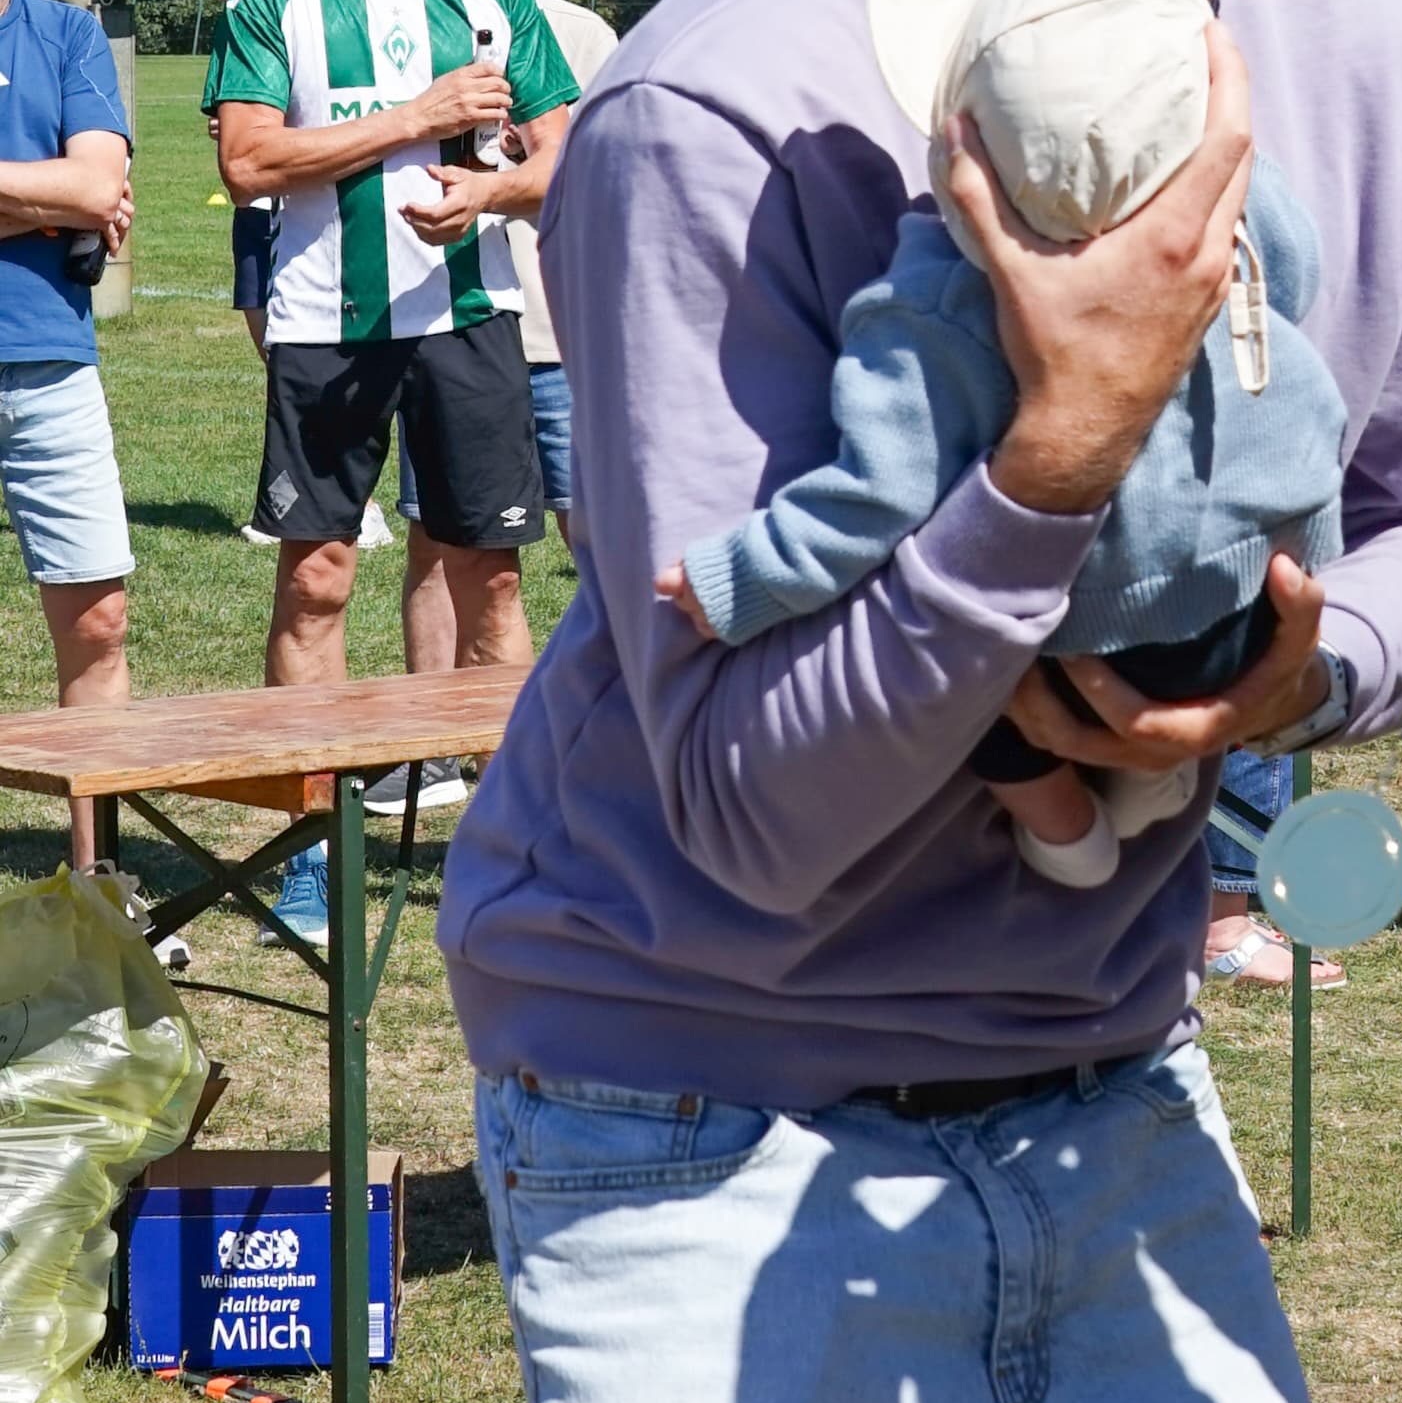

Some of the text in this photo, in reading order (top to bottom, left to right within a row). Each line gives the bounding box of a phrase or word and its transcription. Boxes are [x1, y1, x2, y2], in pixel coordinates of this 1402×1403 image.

[200, 1273, 316, 1291] Weihenstephan
[218, 1294, 301, 1314] Haltbare
[210, 1314, 311, 1351] Milch
